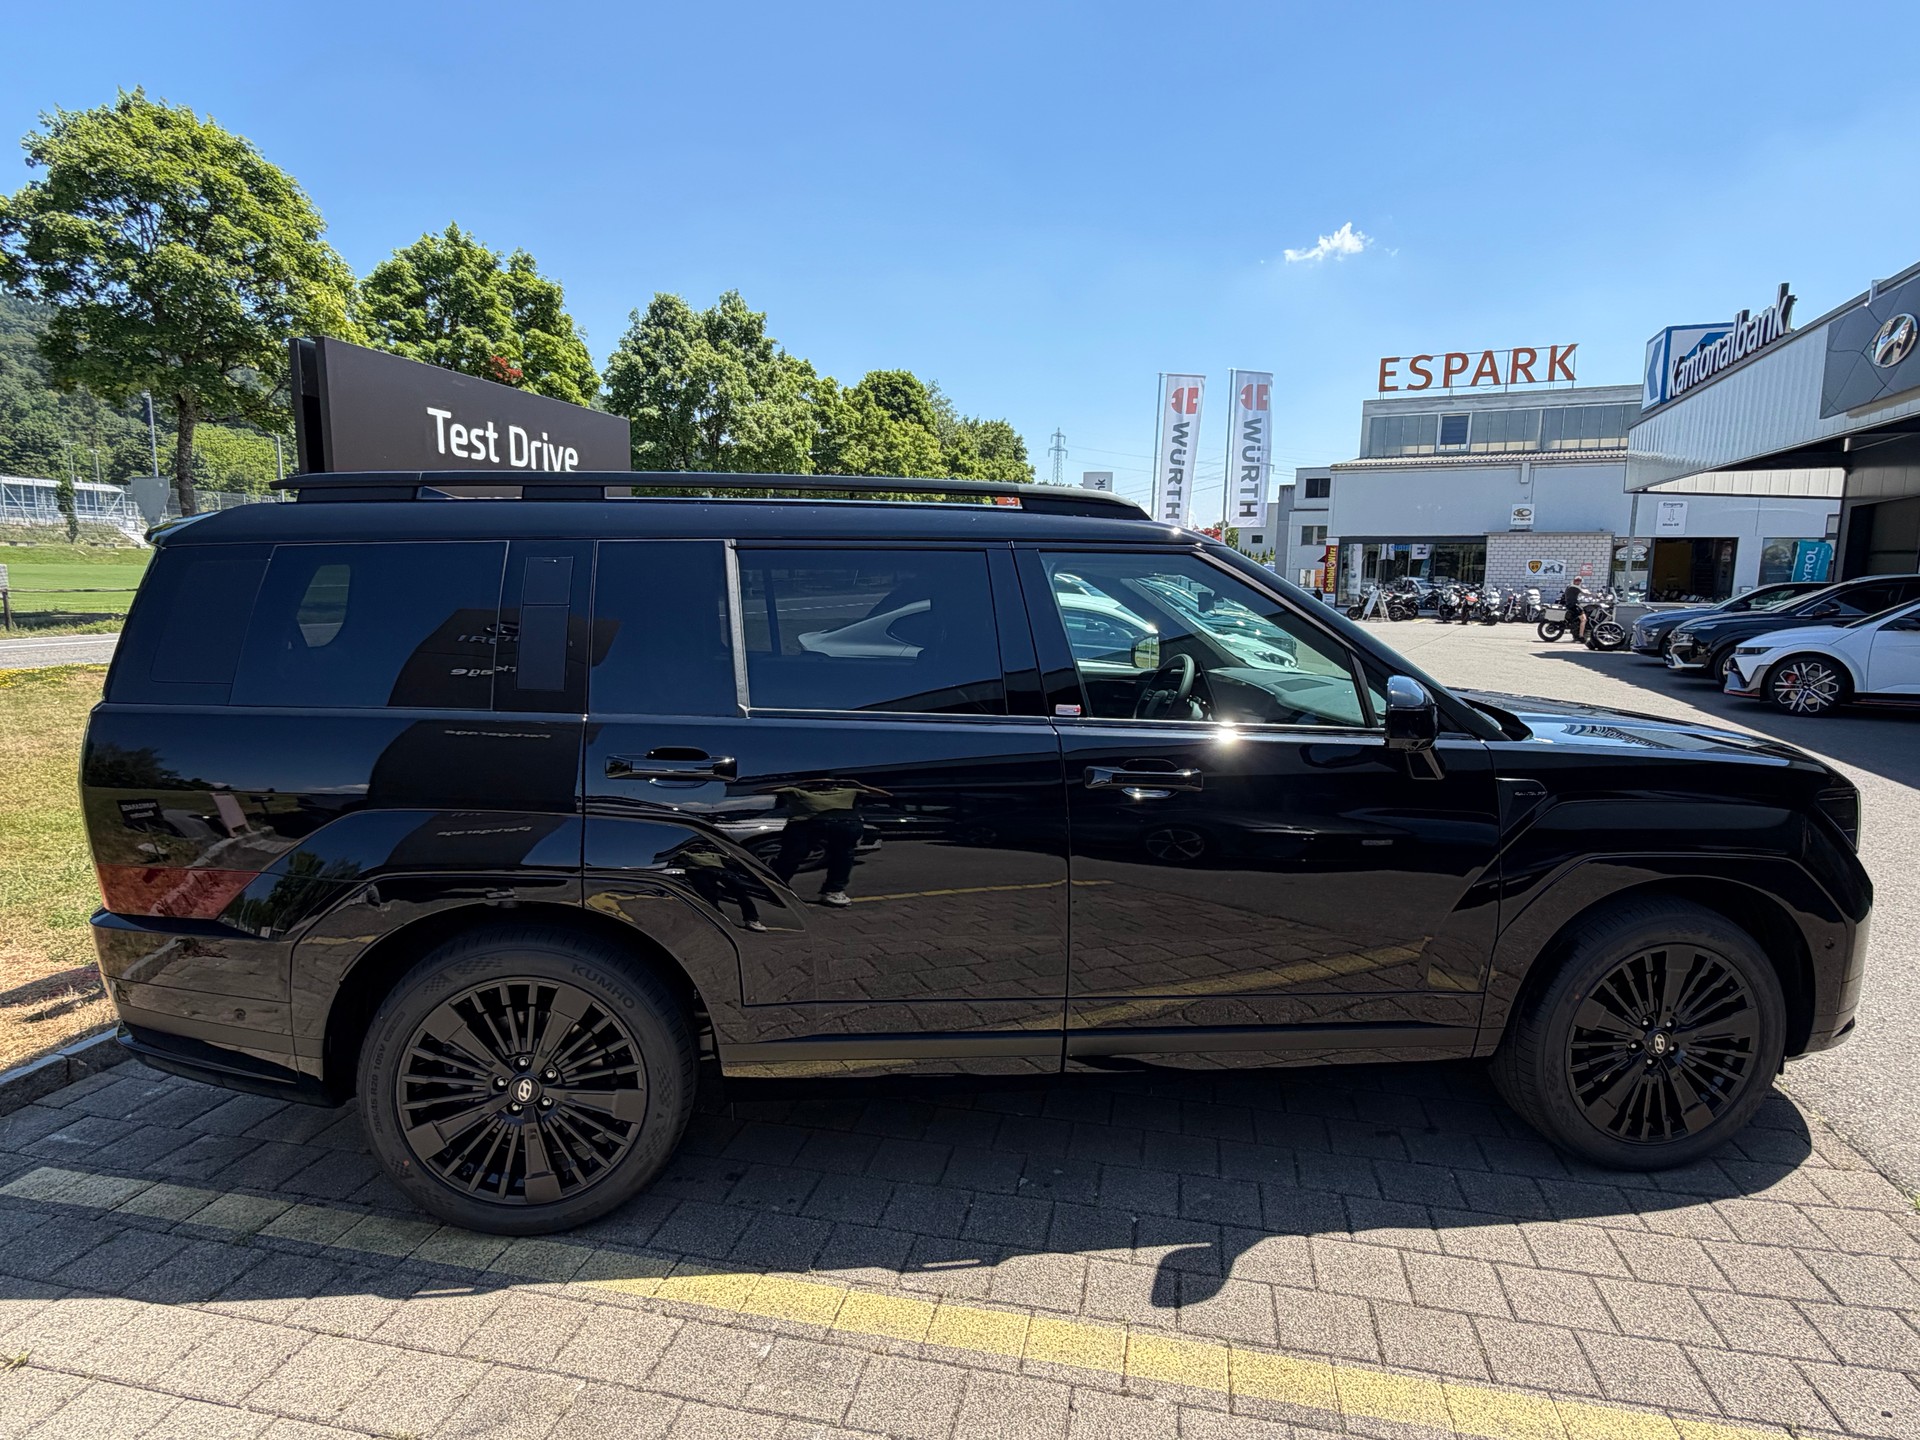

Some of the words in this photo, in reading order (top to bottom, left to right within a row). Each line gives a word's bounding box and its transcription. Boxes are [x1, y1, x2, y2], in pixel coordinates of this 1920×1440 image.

[1378, 343, 1579, 392] ESPARK
[1666, 283, 1796, 400] Kantonalbank
[426, 406, 500, 463] Test
[508, 425, 579, 472] Drive
[1165, 421, 1190, 519] WÜRTH
[1239, 418, 1262, 517] WÜRTH
[1802, 547, 1819, 582] YROL
[571, 963, 635, 1010] KUMHO
